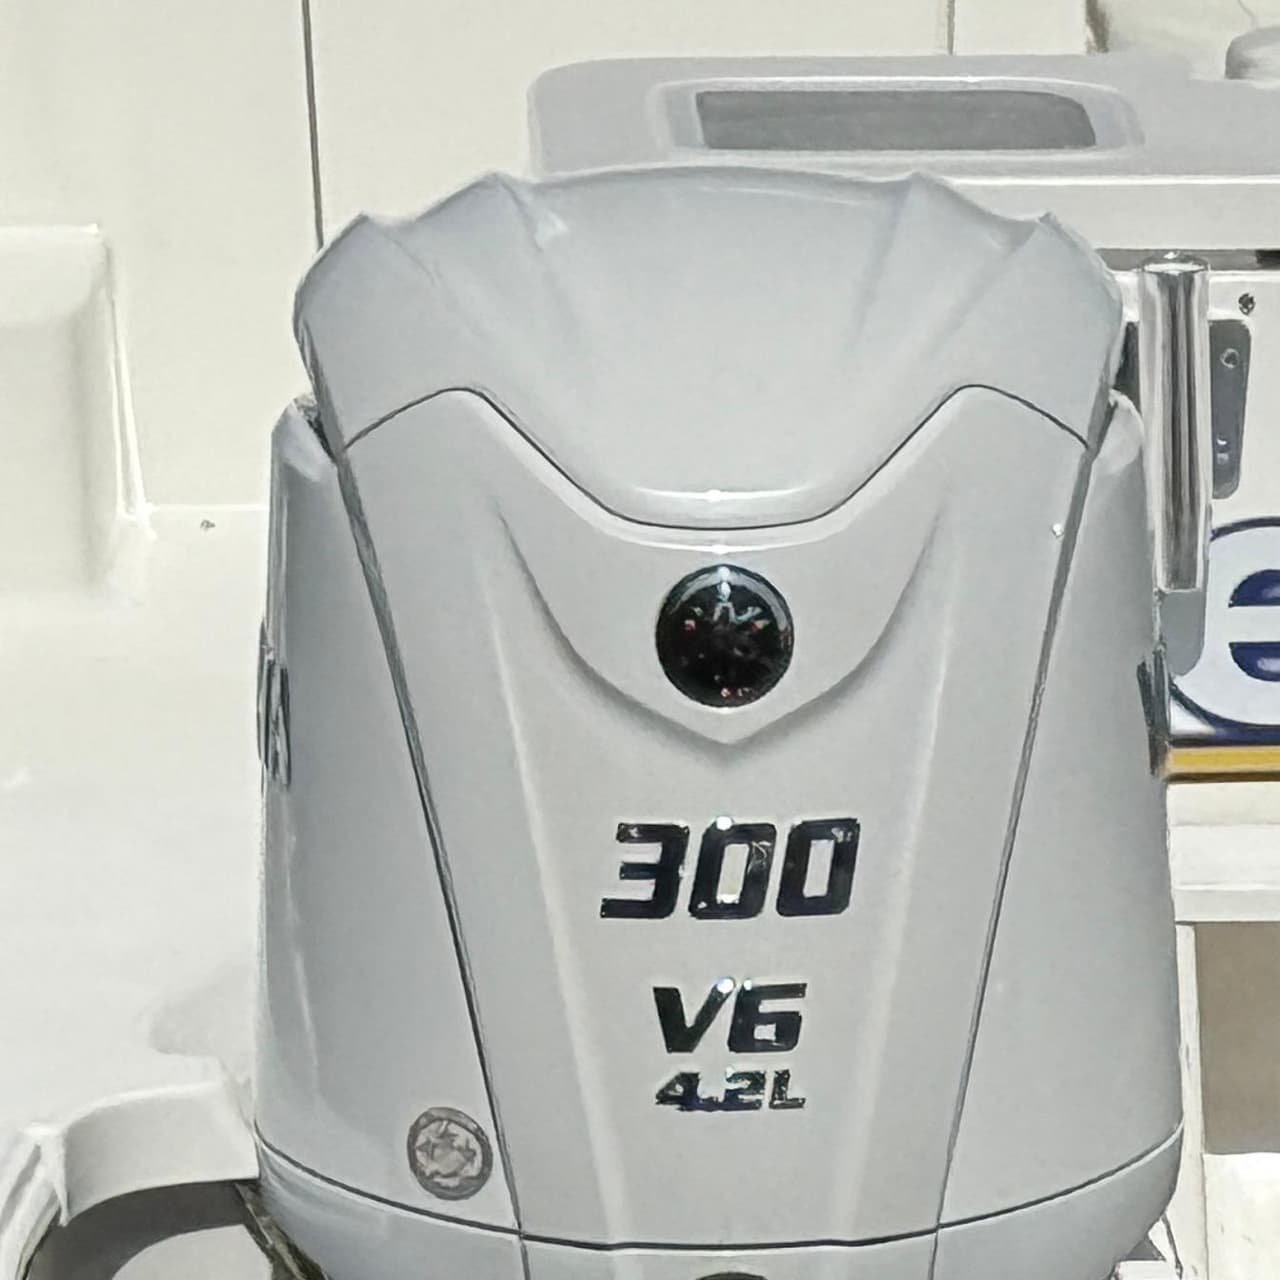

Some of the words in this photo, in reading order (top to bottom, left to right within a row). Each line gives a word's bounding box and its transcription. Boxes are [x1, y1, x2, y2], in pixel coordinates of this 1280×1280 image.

[600, 816, 860, 919] 300
[652, 979, 807, 1053] V6
[655, 1068, 806, 1111] 4.2L
